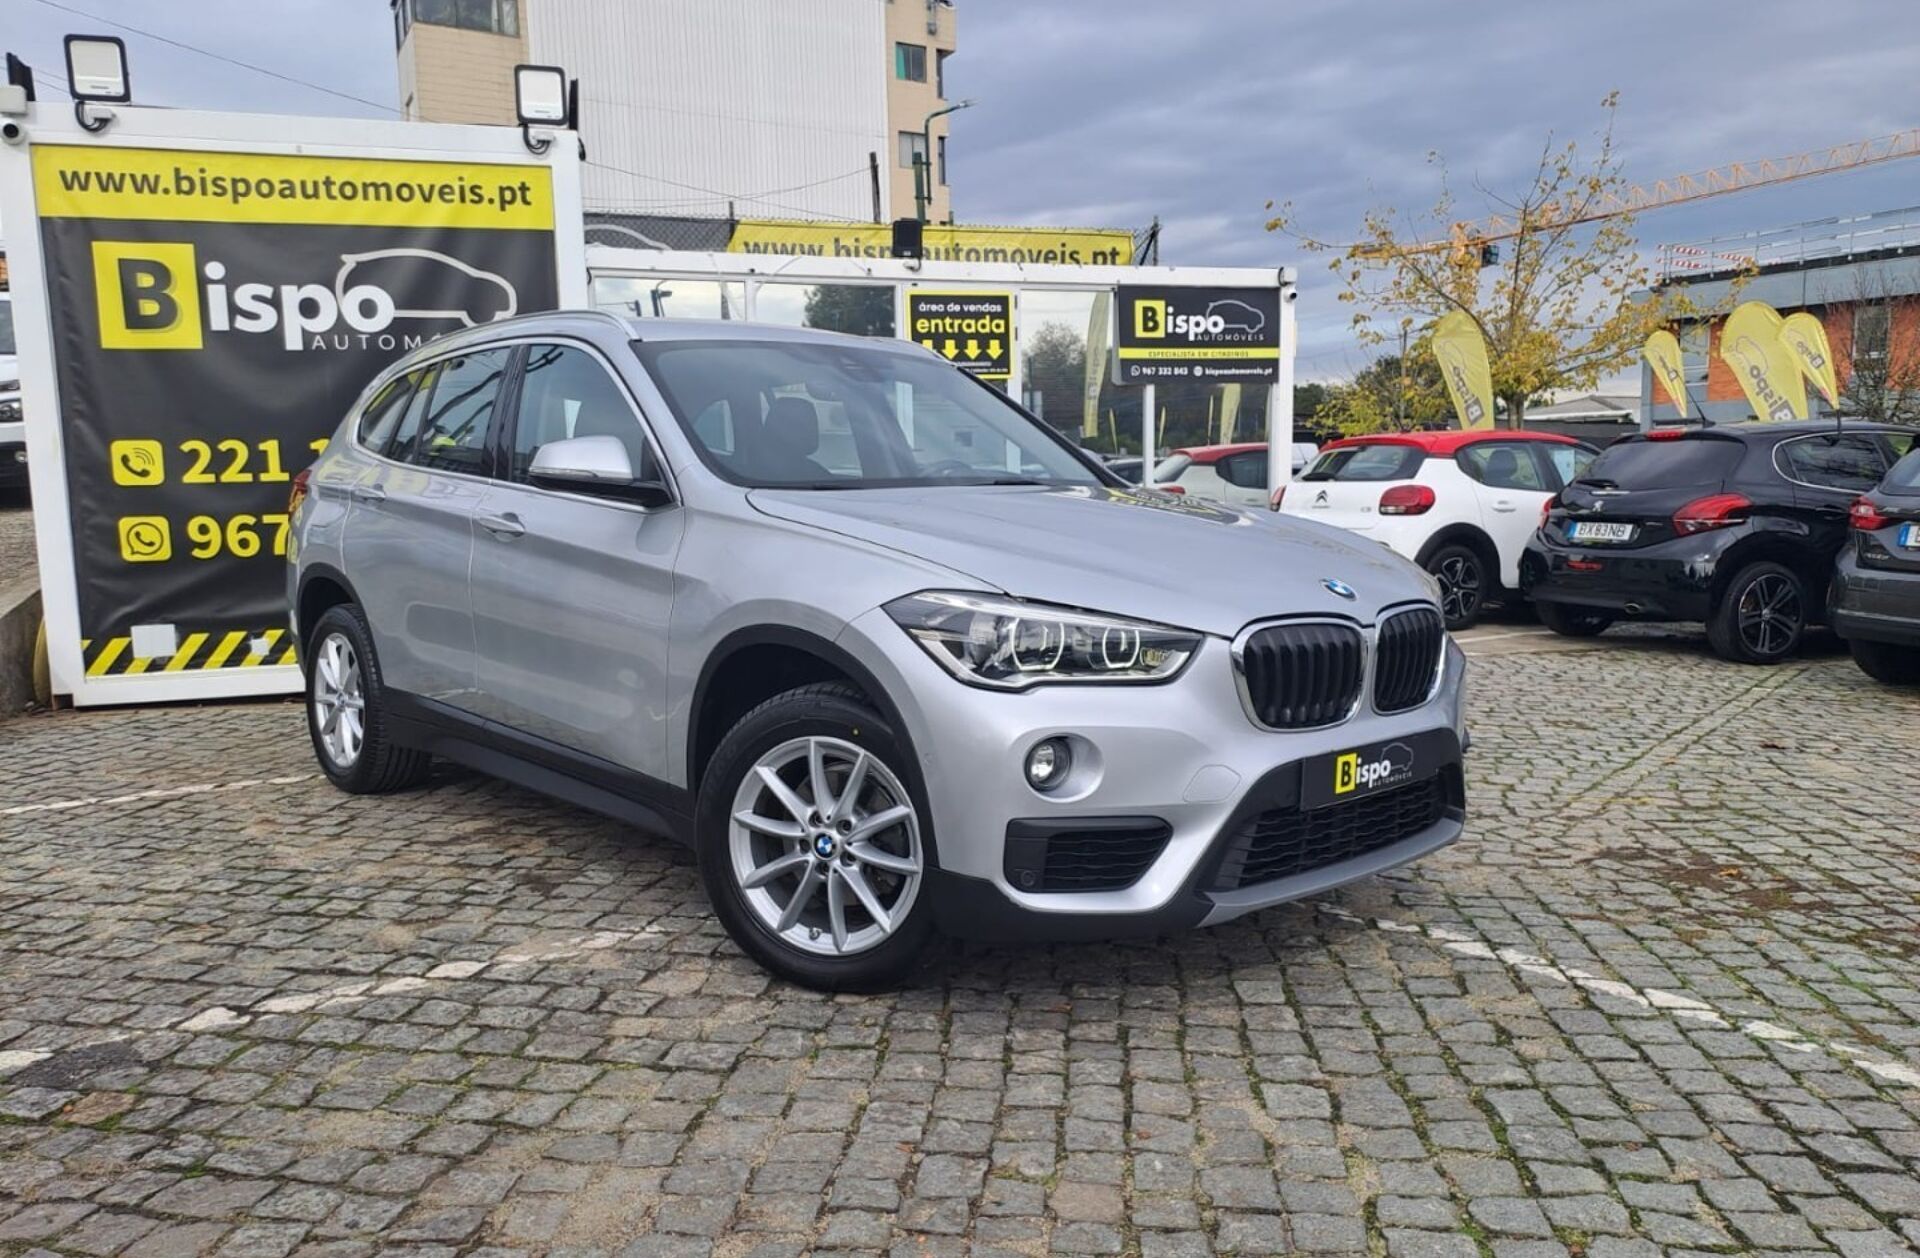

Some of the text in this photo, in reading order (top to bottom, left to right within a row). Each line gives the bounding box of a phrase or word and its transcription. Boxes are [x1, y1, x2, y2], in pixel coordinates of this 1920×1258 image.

[59, 167, 532, 207] www.bispoautomoveis.pt
[117, 258, 395, 350] Bispo
[918, 302, 1002, 312] área de vendas
[916, 315, 1005, 333] entrada
[1142, 306, 1225, 341] Bispo
[1196, 333, 1265, 341] AUTOMÓVEIS
[180, 438, 290, 484] 221
[187, 514, 289, 559] 967
[1340, 757, 1391, 788] Bispo
